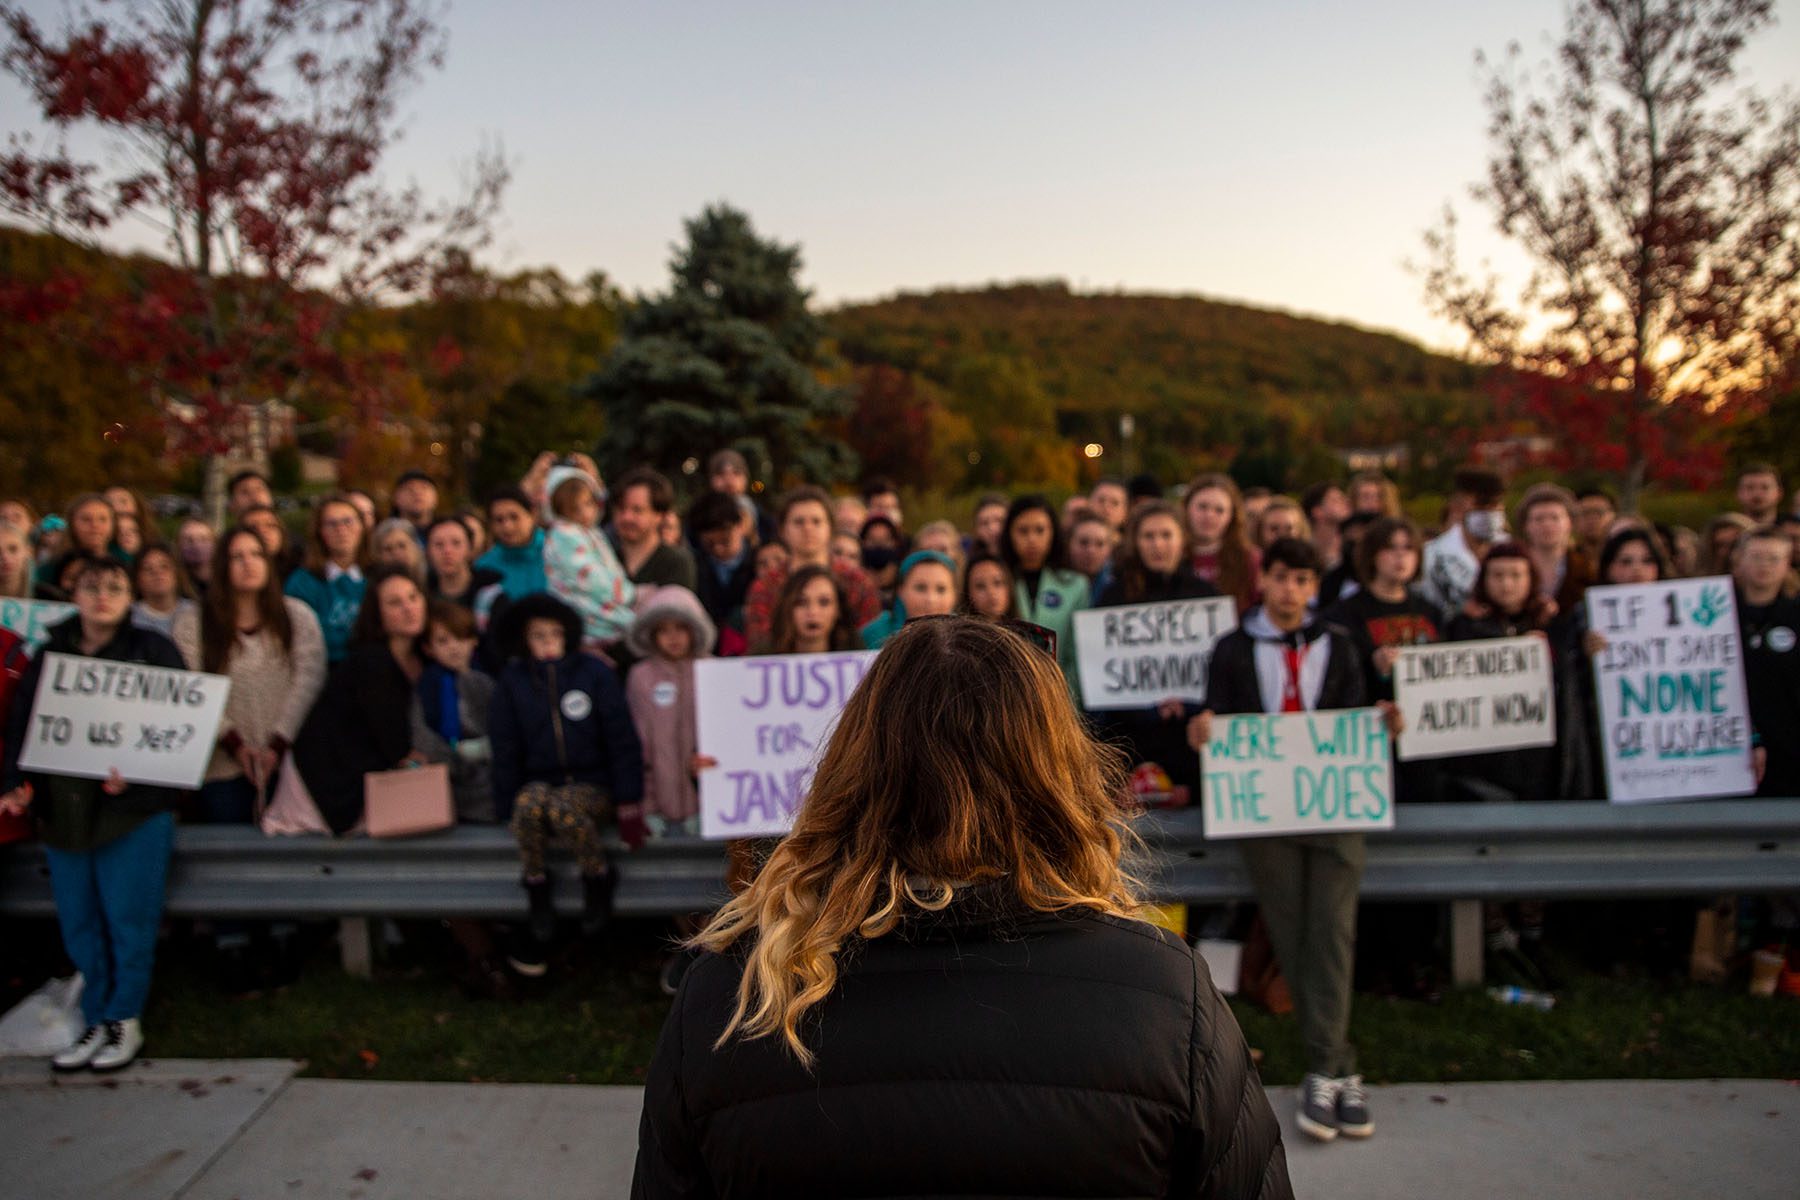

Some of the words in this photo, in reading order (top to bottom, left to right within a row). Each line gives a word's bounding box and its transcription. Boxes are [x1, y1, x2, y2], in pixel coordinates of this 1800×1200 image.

[3, 601, 50, 647] RE
[1103, 601, 1221, 646] RESPECT
[1601, 595, 1645, 632] IF
[1665, 591, 1682, 627] 1
[1401, 644, 1539, 684] INDEPENDENT
[1677, 634, 1736, 666] SAFE
[53, 658, 206, 708] LISTENING
[1103, 653, 1210, 693] SURVIVO
[1618, 669, 1728, 717] NONE
[37, 713, 73, 746] TO
[1416, 696, 1481, 733] AUDIT
[1492, 688, 1548, 727] NOW
[756, 722, 813, 756] FOR
[1307, 709, 1389, 761] WITH
[1613, 721, 1643, 749] OF
[718, 767, 813, 823] JANE
[1205, 769, 1271, 822] THE
[1293, 763, 1389, 821] DOES
